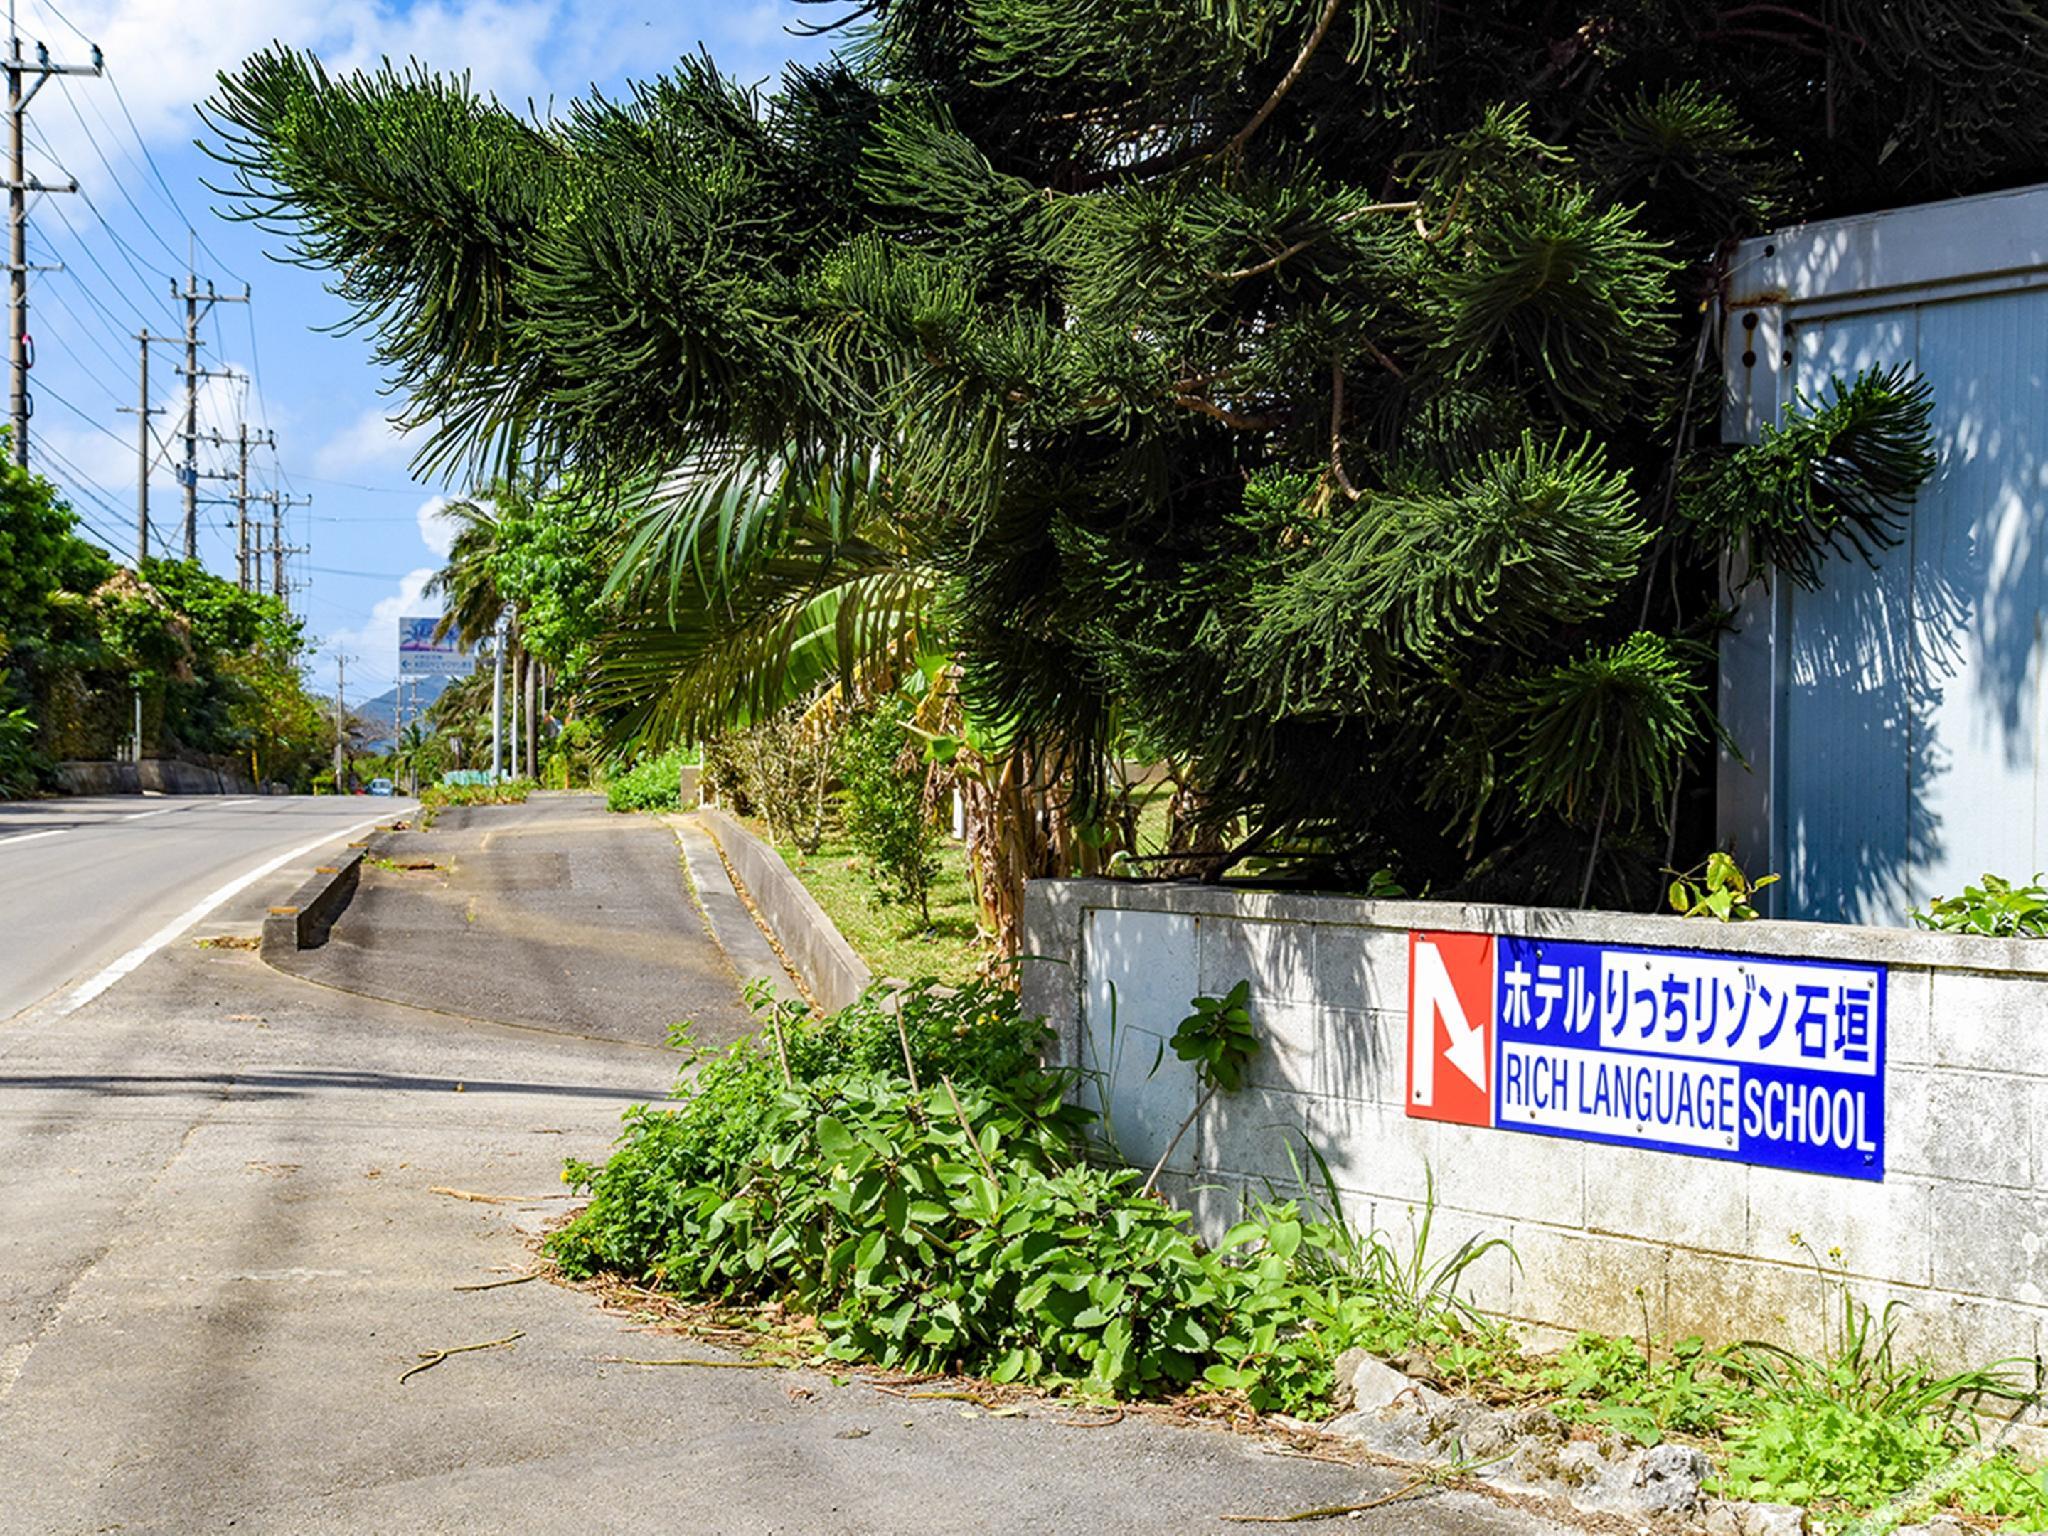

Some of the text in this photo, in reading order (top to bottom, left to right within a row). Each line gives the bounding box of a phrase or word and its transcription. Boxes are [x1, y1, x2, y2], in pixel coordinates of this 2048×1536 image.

[1502, 959, 1871, 1063] ホテルりっちリゾン石垣
[1506, 1053, 1876, 1153] RICH LANGUAGE SCHOOL
